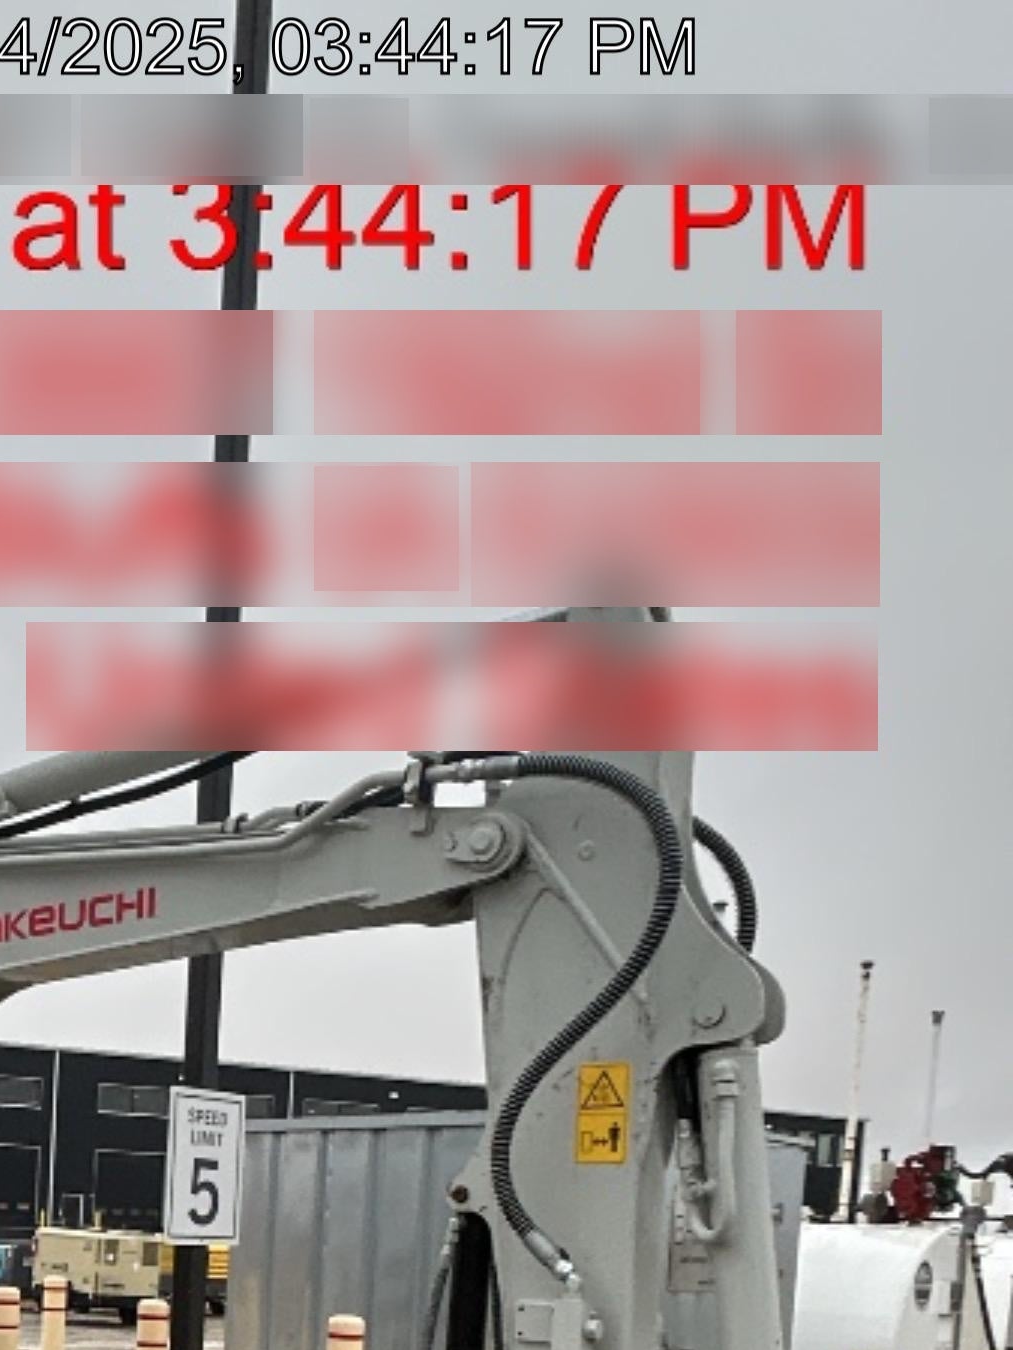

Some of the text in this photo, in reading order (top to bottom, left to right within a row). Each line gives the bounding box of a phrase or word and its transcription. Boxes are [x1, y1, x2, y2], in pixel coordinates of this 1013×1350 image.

[187, 1107, 228, 1127] SPEED
[190, 1128, 224, 1147] LIMIT
[188, 1158, 219, 1226] 5
